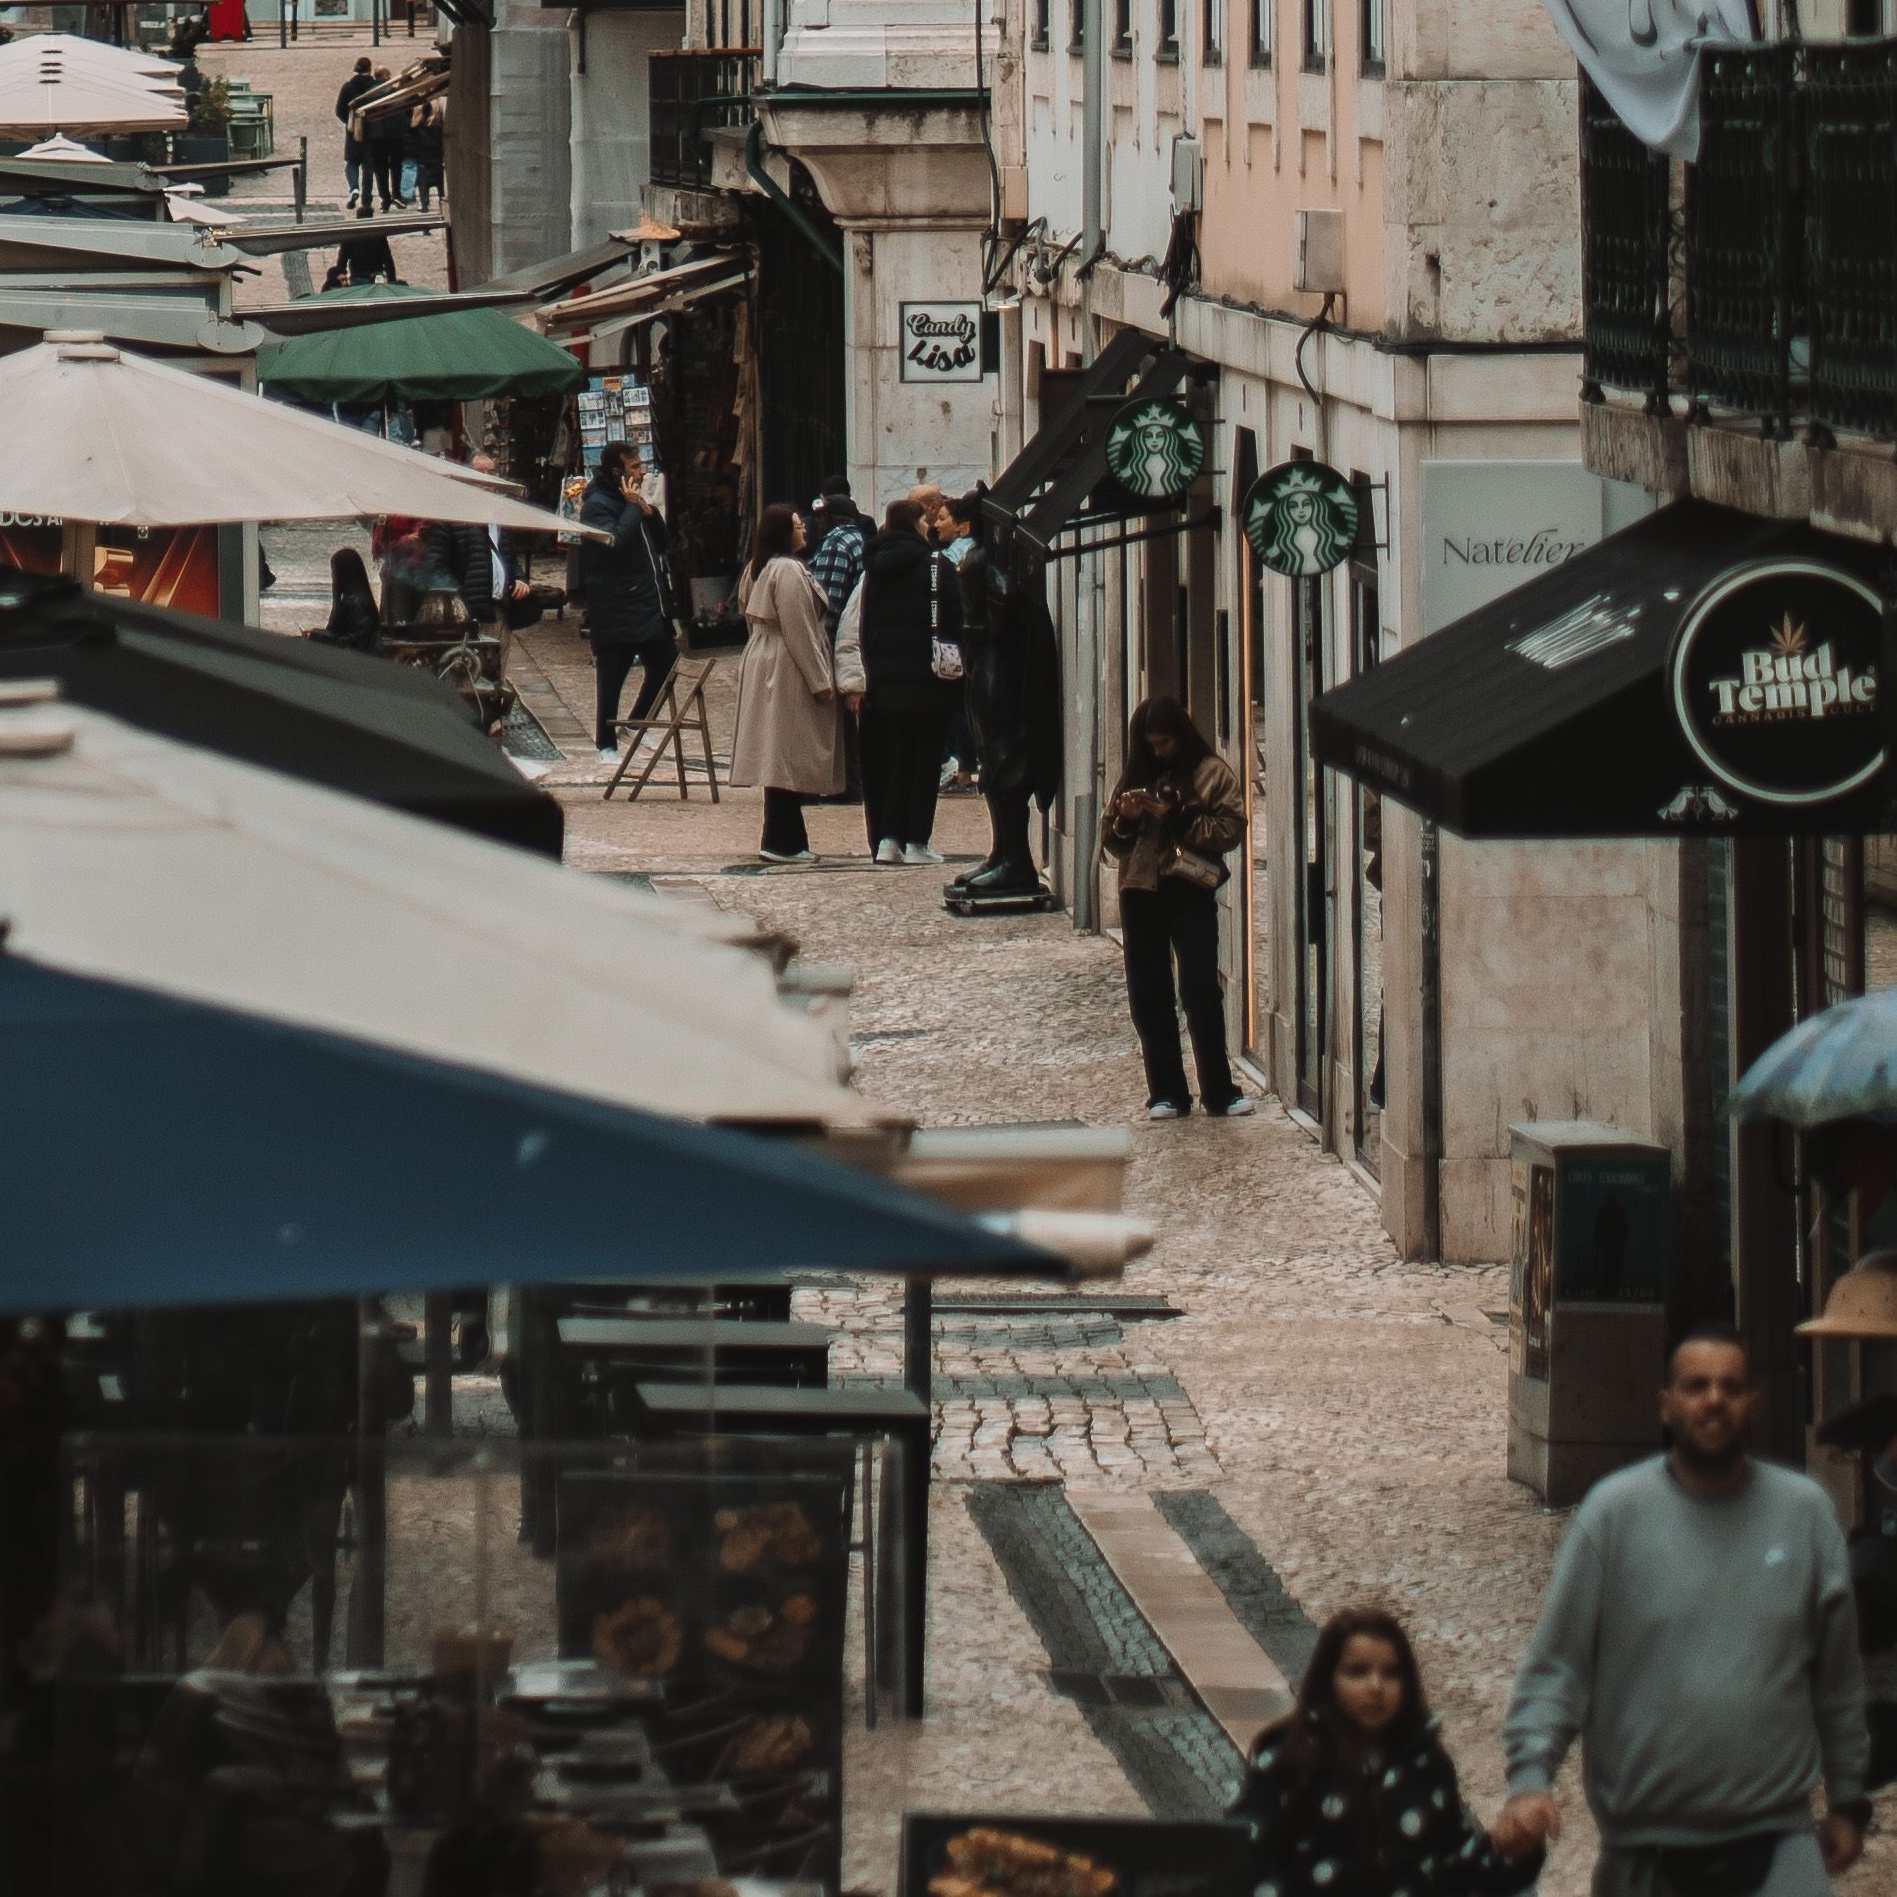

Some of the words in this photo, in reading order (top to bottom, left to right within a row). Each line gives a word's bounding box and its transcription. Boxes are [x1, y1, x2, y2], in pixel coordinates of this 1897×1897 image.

[906, 312, 977, 345] Candy
[906, 339, 976, 372] Lisa
[1742, 642, 1833, 685] Bud
[1708, 666, 1878, 717] Temple
